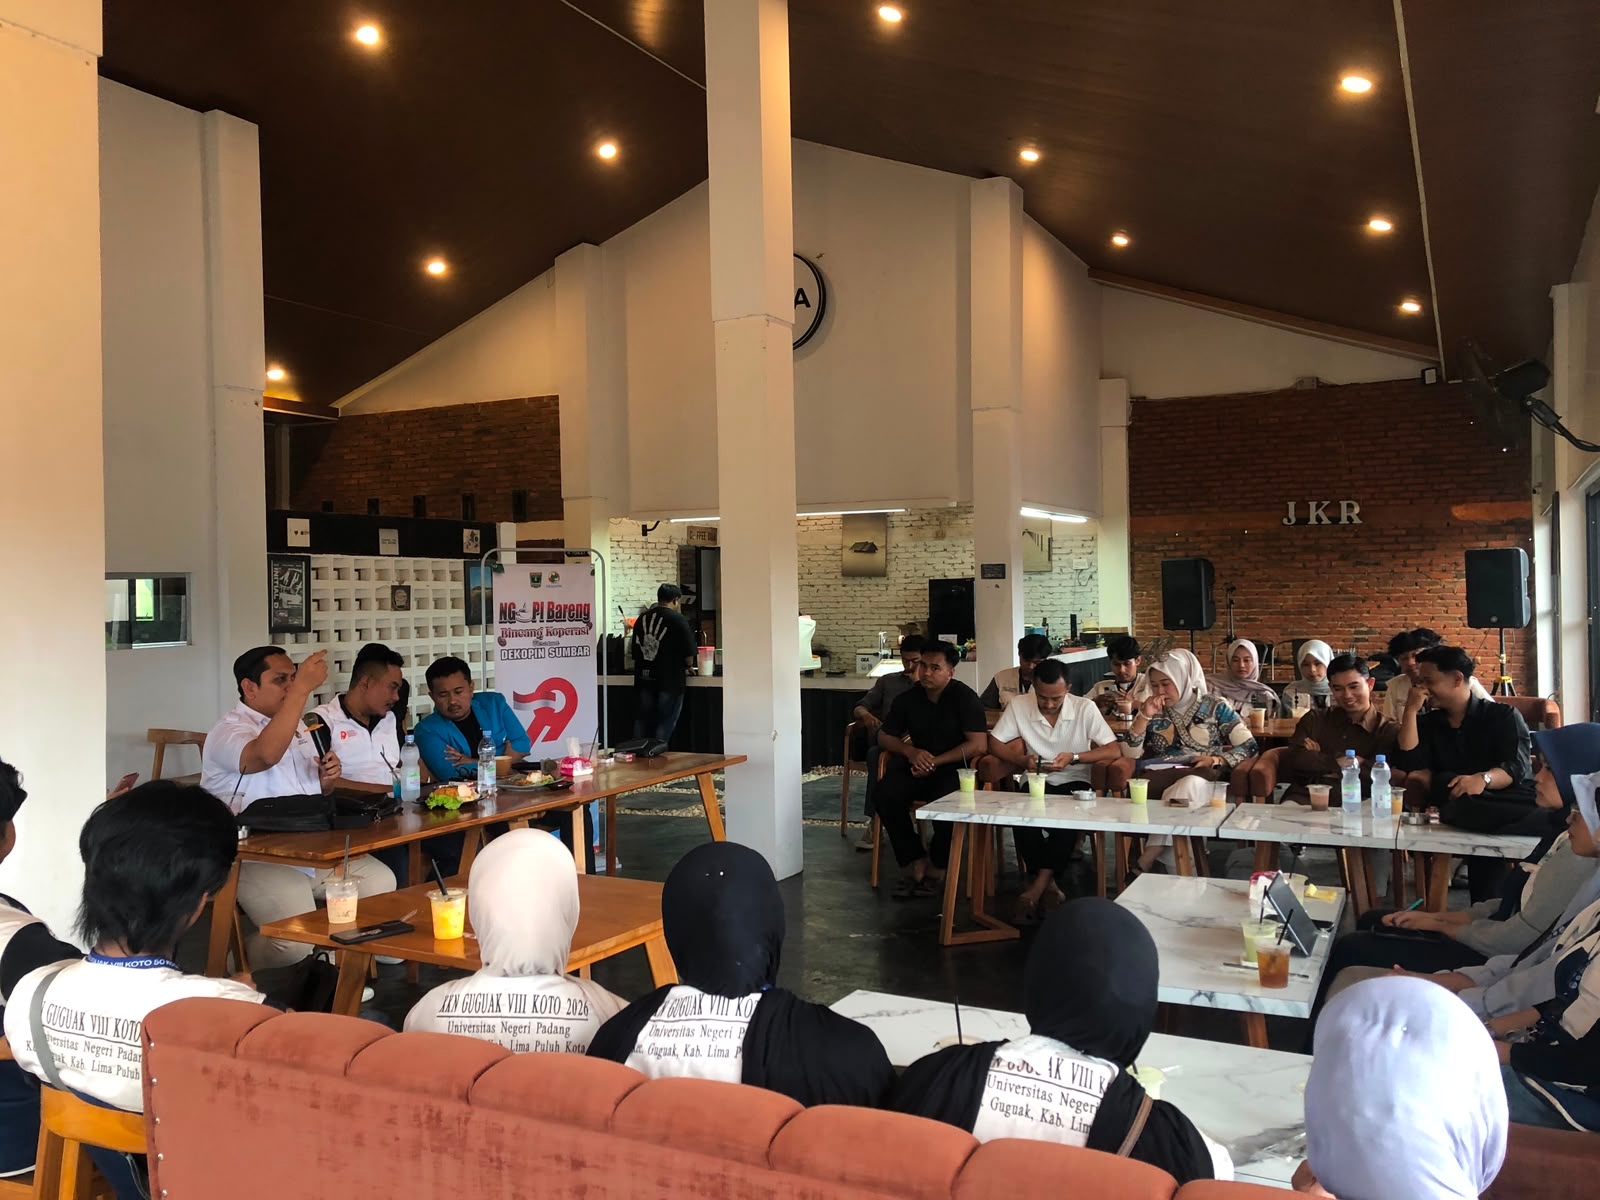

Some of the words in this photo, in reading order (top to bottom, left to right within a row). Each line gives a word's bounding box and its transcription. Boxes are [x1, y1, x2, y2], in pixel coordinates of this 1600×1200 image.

[546, 601, 590, 623] Bareng
[501, 648, 545, 660] DEKOPIN
[548, 645, 590, 658] SUMBAR
[125, 959, 152, 968] KOTO
[461, 992, 502, 1013] GUGUAK
[507, 993, 527, 1014] VIII
[531, 994, 561, 1015] KOTO
[566, 998, 589, 1017] 2026
[667, 993, 704, 1019] GUGUAK
[709, 994, 729, 1016] VIII
[735, 995, 757, 1018] KO
[47, 1003, 85, 1031] GUGUAK
[90, 1014, 109, 1036] VIII
[113, 1018, 141, 1042] KOTO
[447, 1020, 496, 1034] Universitas
[500, 1021, 531, 1037] Negeri
[536, 1022, 571, 1037] Padang
[649, 1024, 695, 1038] Universitas
[700, 1024, 733, 1041] Negeri
[83, 1040, 113, 1058] Negeri
[117, 1046, 142, 1063] Pada
[510, 1040, 530, 1052] Lima
[534, 1040, 560, 1053] Puluh
[565, 1040, 586, 1054] Kota
[683, 1043, 703, 1057] Kab.
[706, 1044, 730, 1058] Lima
[70, 1056, 86, 1070] Kab.
[91, 1060, 112, 1074] Lima
[116, 1064, 140, 1080] Puluh
[1071, 1061, 1094, 1090] VIII
[986, 1073, 1053, 1103] Universitas
[990, 1096, 1034, 1121] Guguak,
[1040, 1107, 1065, 1129] Kab.
[1070, 1115, 1092, 1135] Lim
